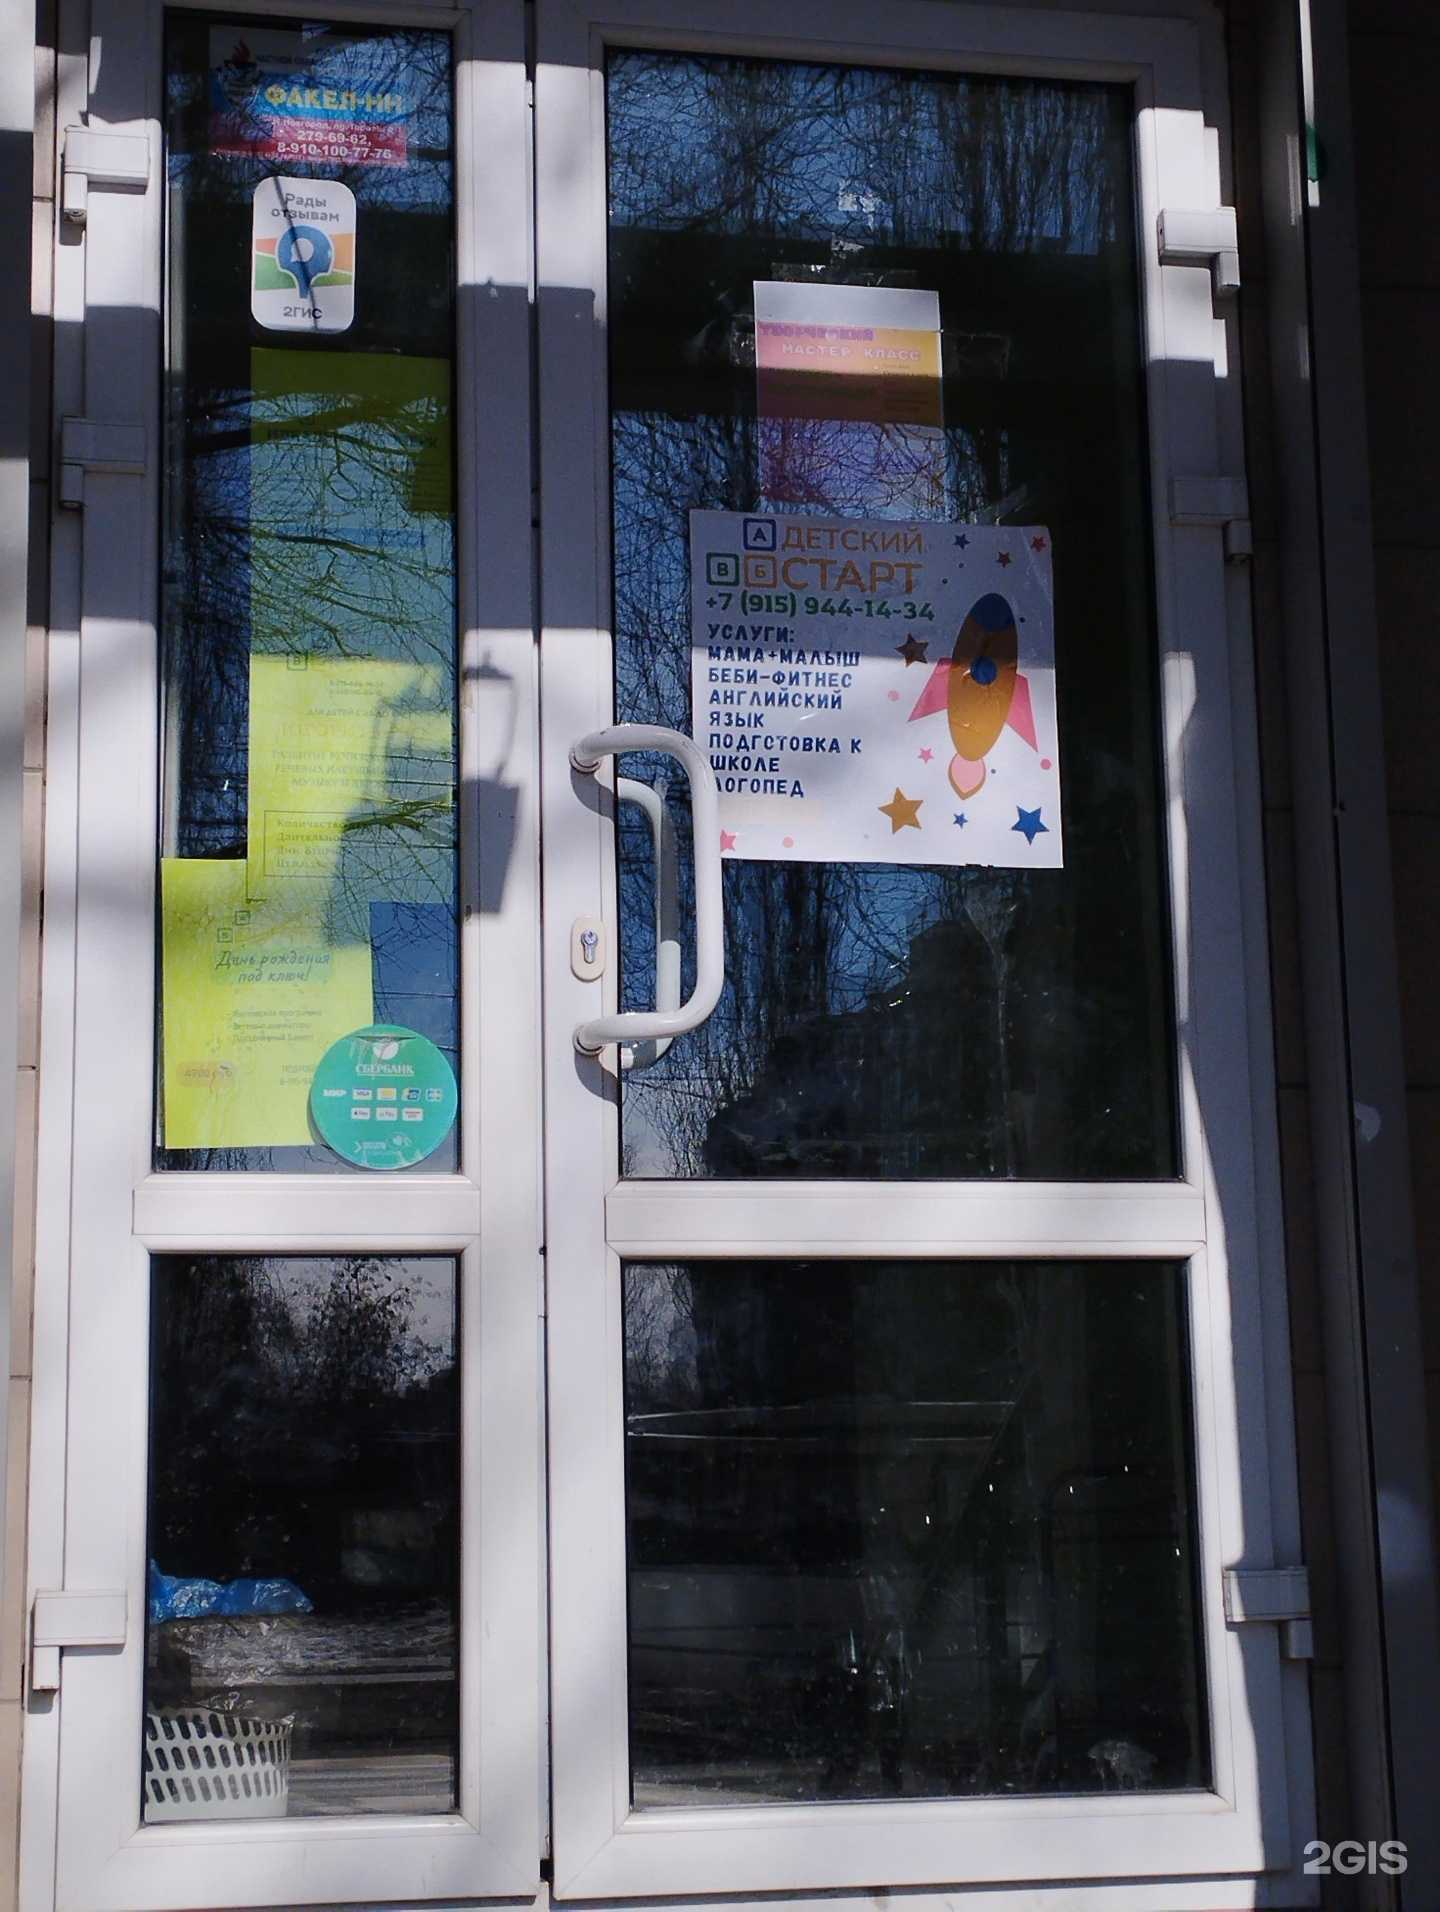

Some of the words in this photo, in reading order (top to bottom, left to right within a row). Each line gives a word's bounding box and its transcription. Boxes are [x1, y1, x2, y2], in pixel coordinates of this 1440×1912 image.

[285, 193, 327, 208] Рады
[271, 208, 340, 222] отзывам
[283, 306, 323, 320] 2ГИС
[782, 343, 850, 357] МАСТЕР
[864, 349, 921, 361] КЛАСС
[753, 528, 767, 542] А
[782, 526, 923, 553] ДЕТСКИЙ
[783, 557, 924, 593] СТАРТ
[706, 592, 733, 611] +7
[741, 590, 797, 617] (915)
[804, 597, 935, 621] 944-14-34
[708, 624, 795, 643] УСЛУГИ:
[708, 645, 861, 667] МАМА+МАЛЫШ
[708, 667, 853, 688] БЕБИ-ФИТНЕС
[709, 687, 843, 709] АНГЛИЙСКИЙ
[709, 711, 765, 728] ЯЗЫК
[850, 739, 862, 754] К
[710, 755, 780, 772] ШКОЛЕ
[238, 968, 264, 983] под
